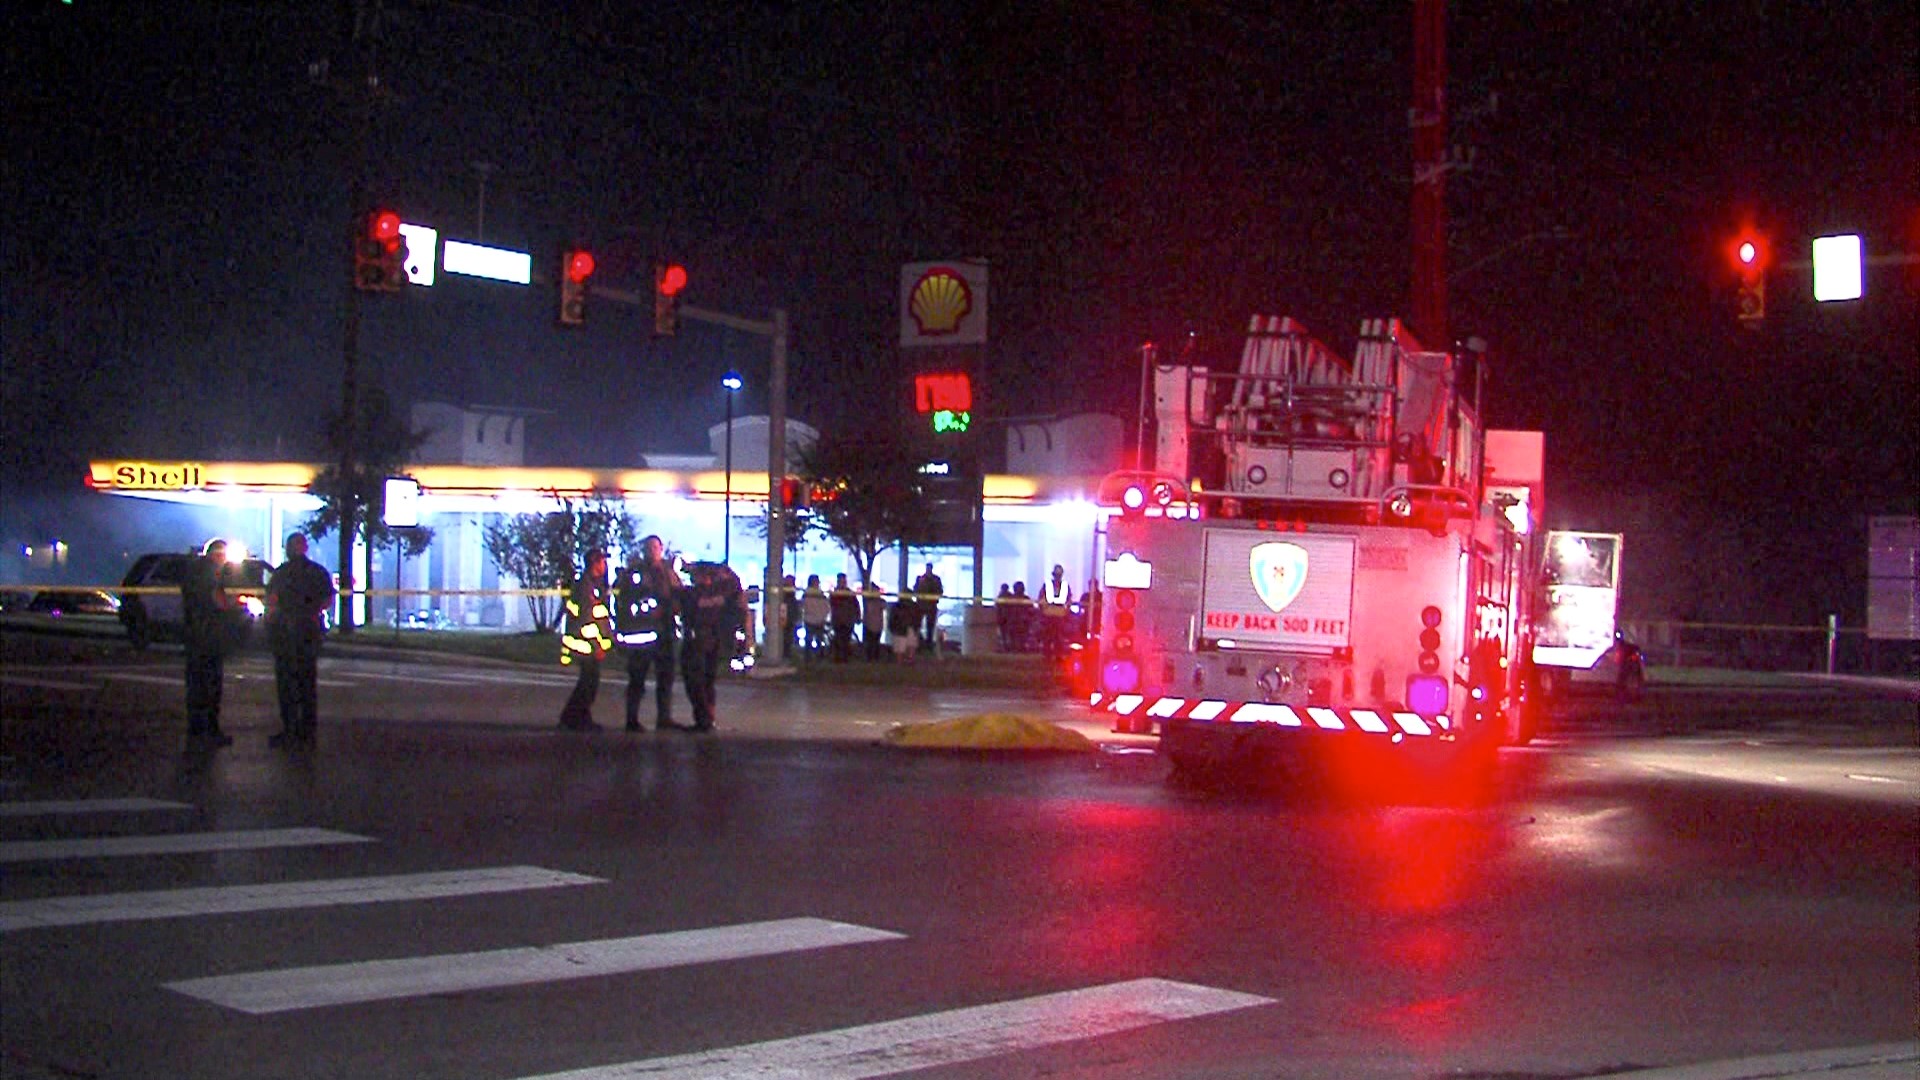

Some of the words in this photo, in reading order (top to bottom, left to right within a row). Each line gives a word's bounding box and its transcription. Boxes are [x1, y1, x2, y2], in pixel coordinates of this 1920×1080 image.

[116, 466, 199, 486] Shell
[1206, 612, 1240, 628] KEEP
[1244, 614, 1277, 630] BACK
[1283, 616, 1309, 633] 500
[1313, 618, 1345, 634] FEET
